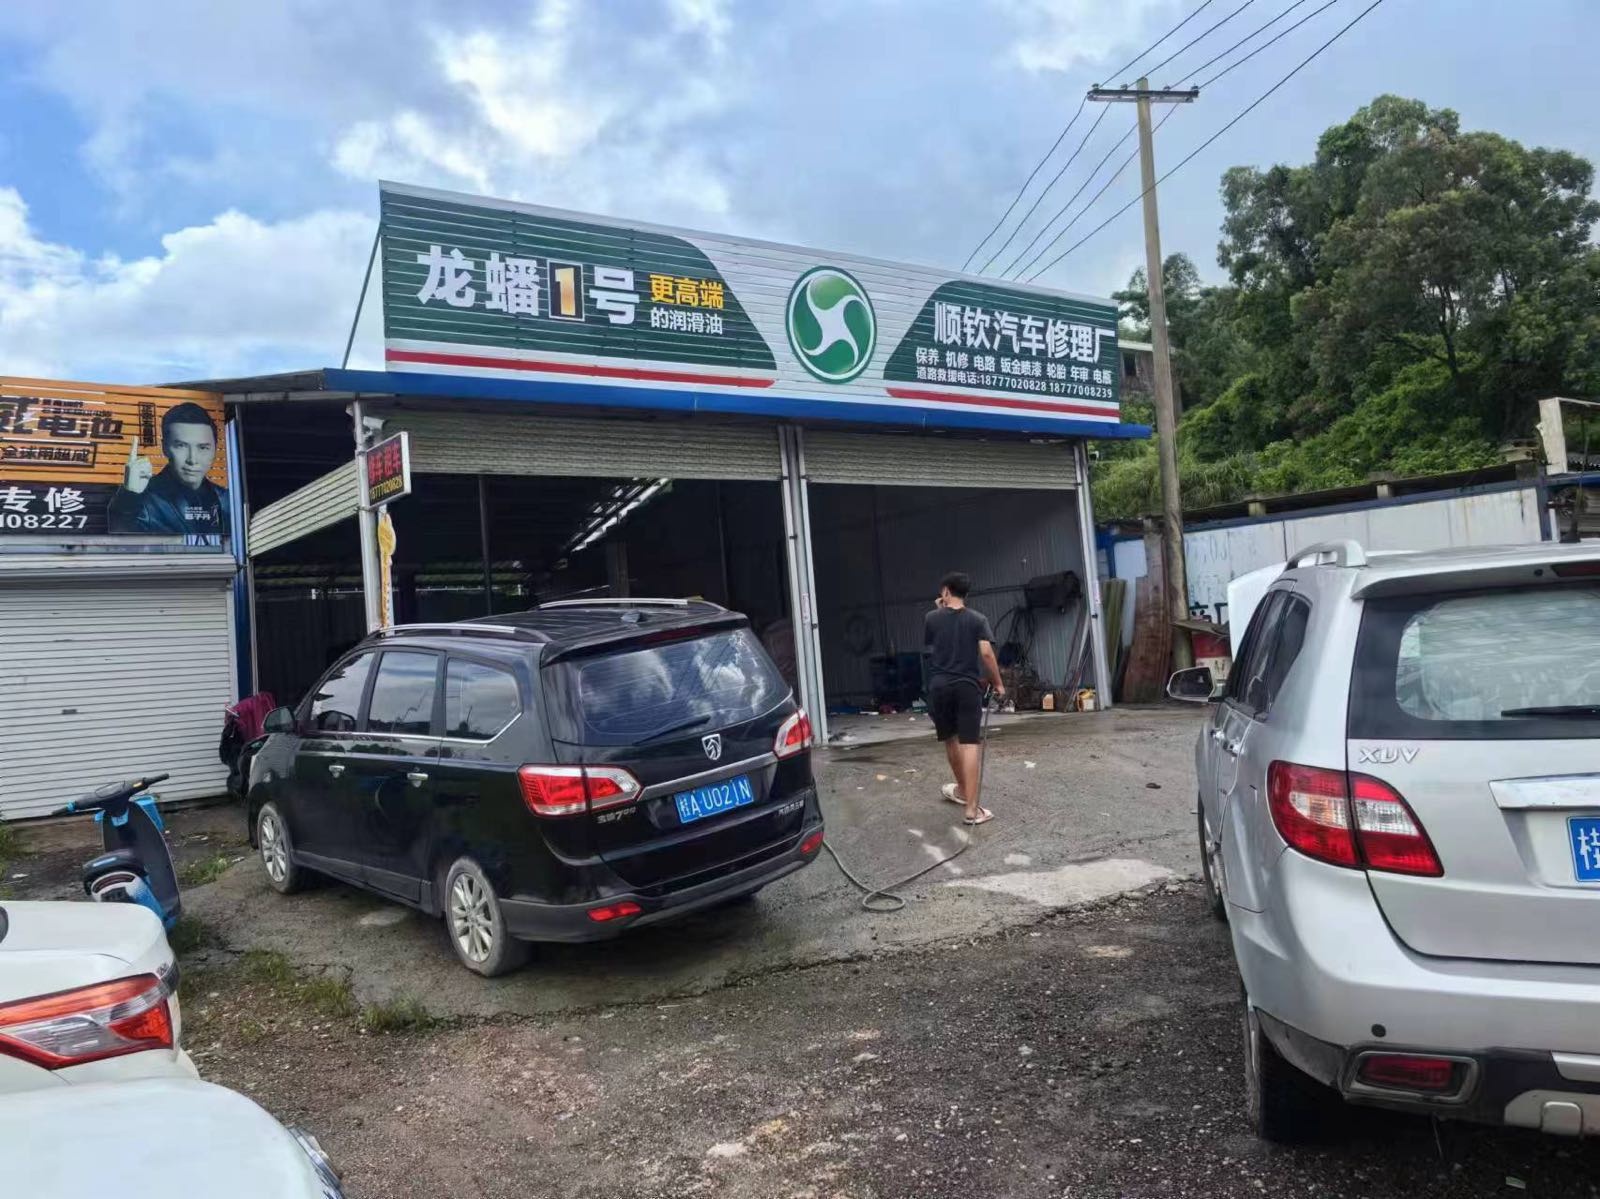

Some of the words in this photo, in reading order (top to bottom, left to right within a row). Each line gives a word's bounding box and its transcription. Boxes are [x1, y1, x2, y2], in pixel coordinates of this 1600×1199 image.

[416, 244, 640, 325] 龙蟠1号
[649, 273, 724, 309] 更高端
[650, 307, 724, 335] 的润滑油
[934, 301, 1116, 364] 顺钦汽车修理厂
[915, 346, 940, 366] 保养
[945, 350, 969, 369] 机修
[973, 355, 996, 373] 电路
[1000, 357, 1042, 377] 钣金喷漆
[1046, 362, 1067, 380] 轮胎
[1070, 365, 1089, 382] 年审
[1049, 382, 1113, 398] 18777008239
